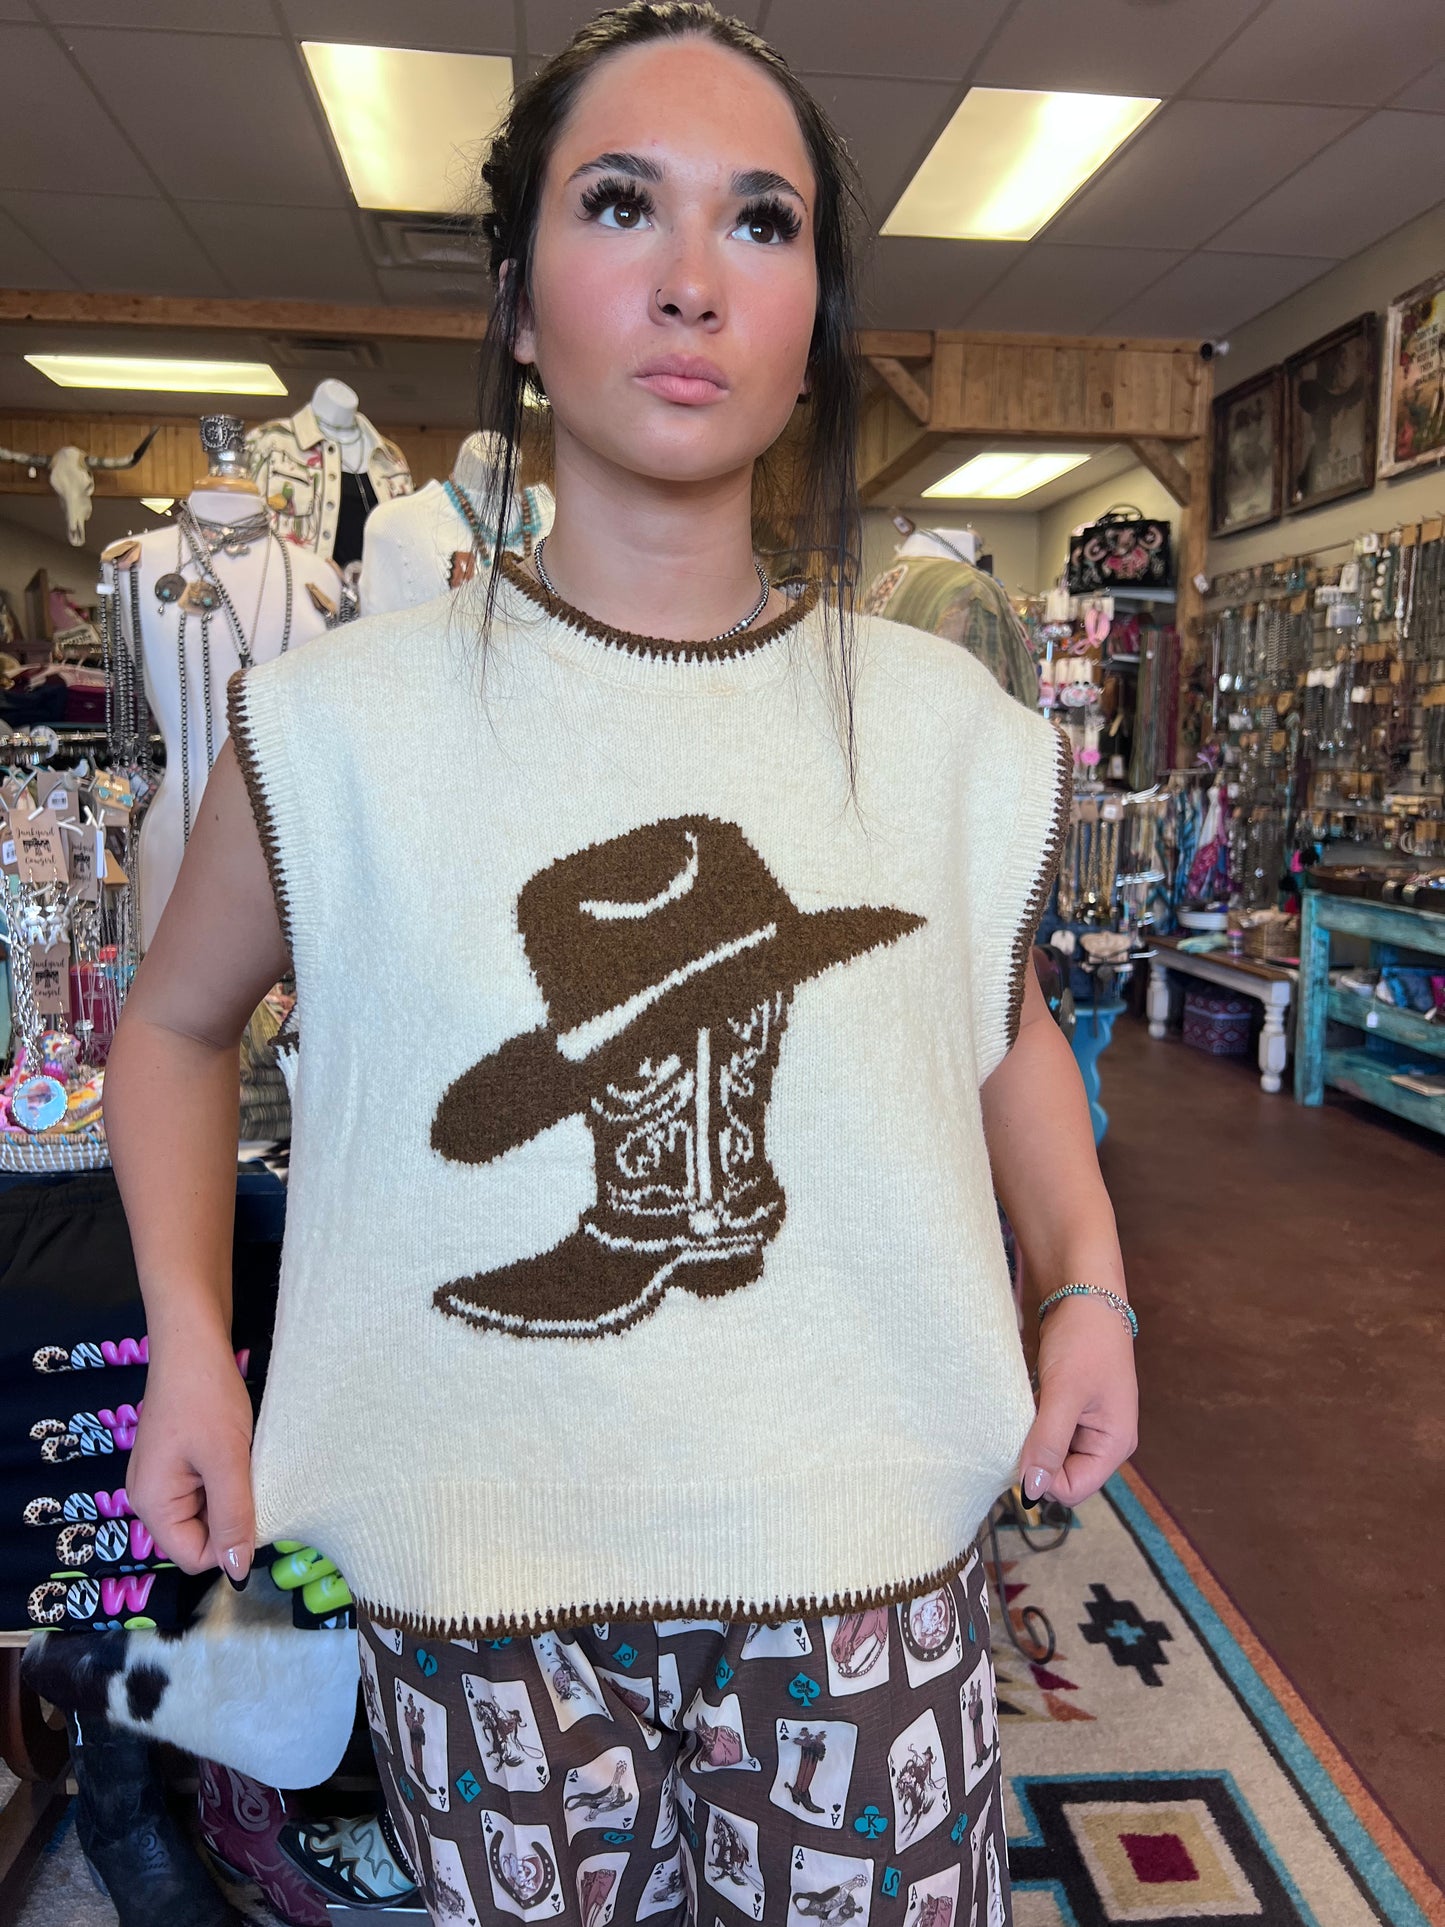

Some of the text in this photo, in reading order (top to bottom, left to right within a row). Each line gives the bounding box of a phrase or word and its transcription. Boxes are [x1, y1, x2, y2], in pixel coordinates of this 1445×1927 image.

[596, 1628, 605, 1637] A
[395, 1638, 401, 1651] A
[796, 1637, 806, 1652] A
[396, 1681, 402, 1693] A
[465, 1675, 473, 1688] A
[779, 1721, 789, 1733] A
[569, 1769, 579, 1778] A
[537, 1775, 547, 1785] A
[438, 1796, 446, 1809] A
[484, 1812, 492, 1824] A
[831, 1813, 841, 1826] A
[795, 1848, 805, 1861] A
[911, 1885, 918, 1900] A
[552, 1901, 561, 1912] A
[752, 1903, 761, 1917] A
[604, 1911, 612, 1922] A
